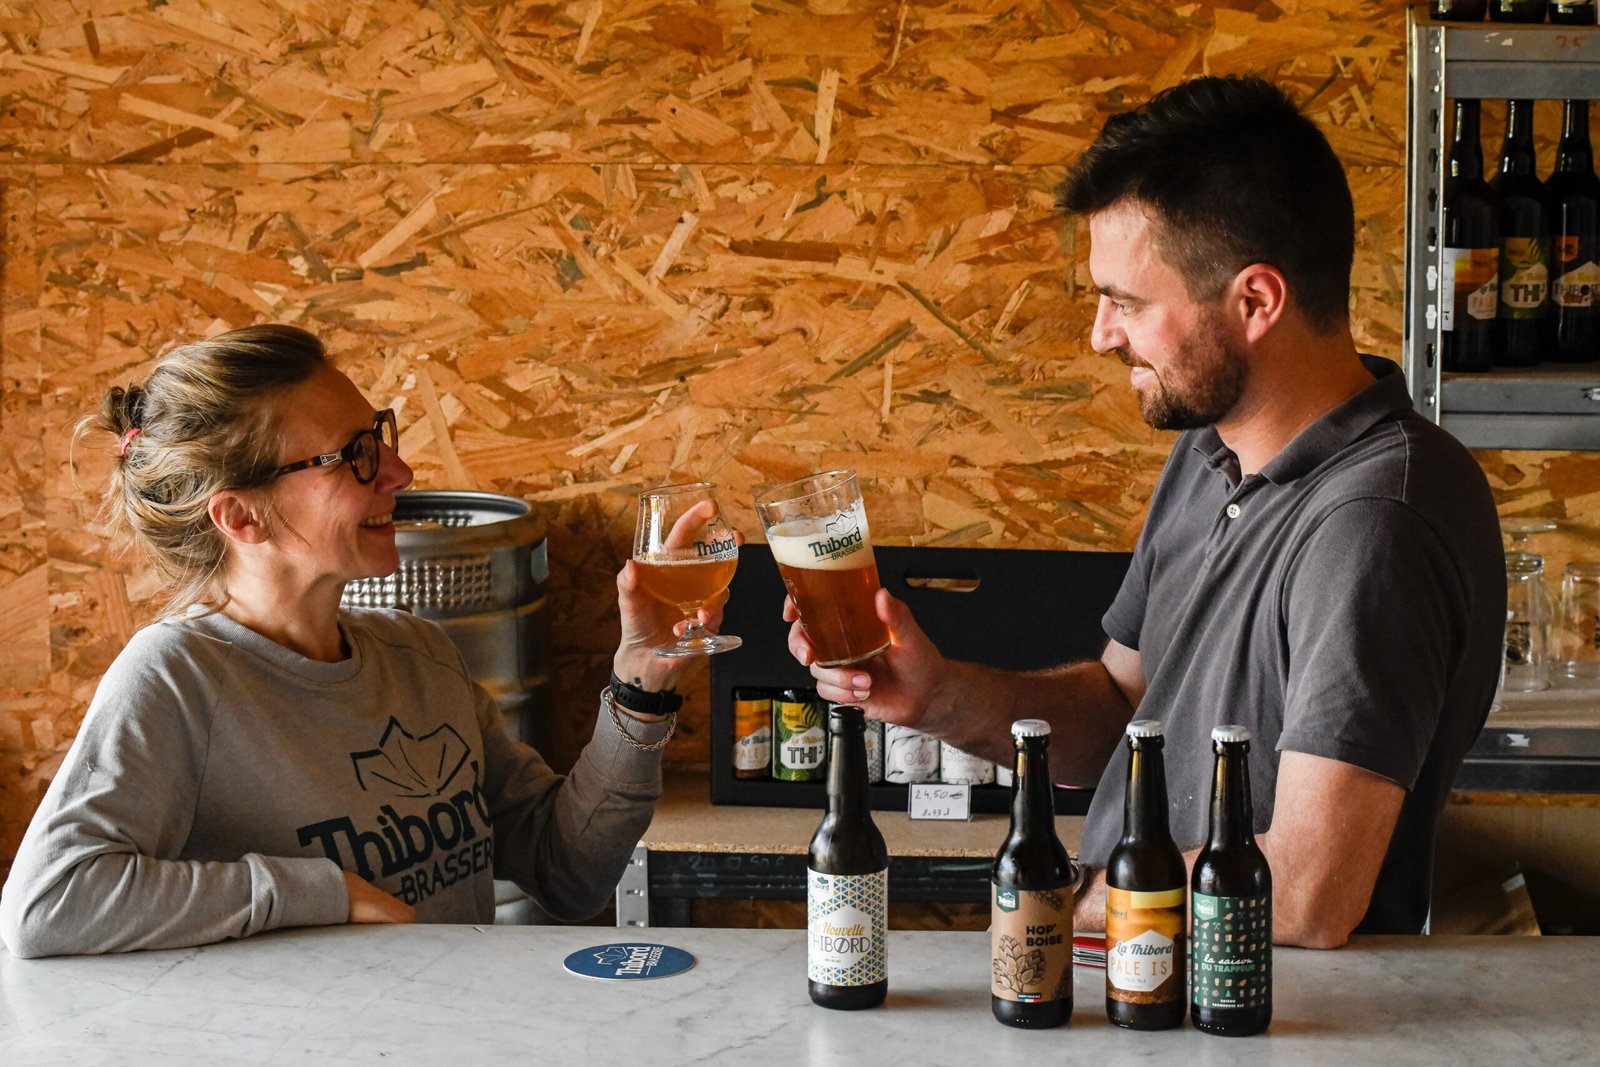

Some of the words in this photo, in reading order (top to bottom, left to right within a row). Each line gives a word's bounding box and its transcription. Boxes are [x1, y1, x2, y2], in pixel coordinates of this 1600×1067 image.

[808, 527, 862, 559] Thibord
[831, 542, 864, 561] BRASSERIE
[1130, 943, 1173, 955] Thibord
[615, 946, 651, 975] Thibord
[1201, 962, 1213, 972] DU
[1213, 963, 1256, 973] TRAPPEUR
